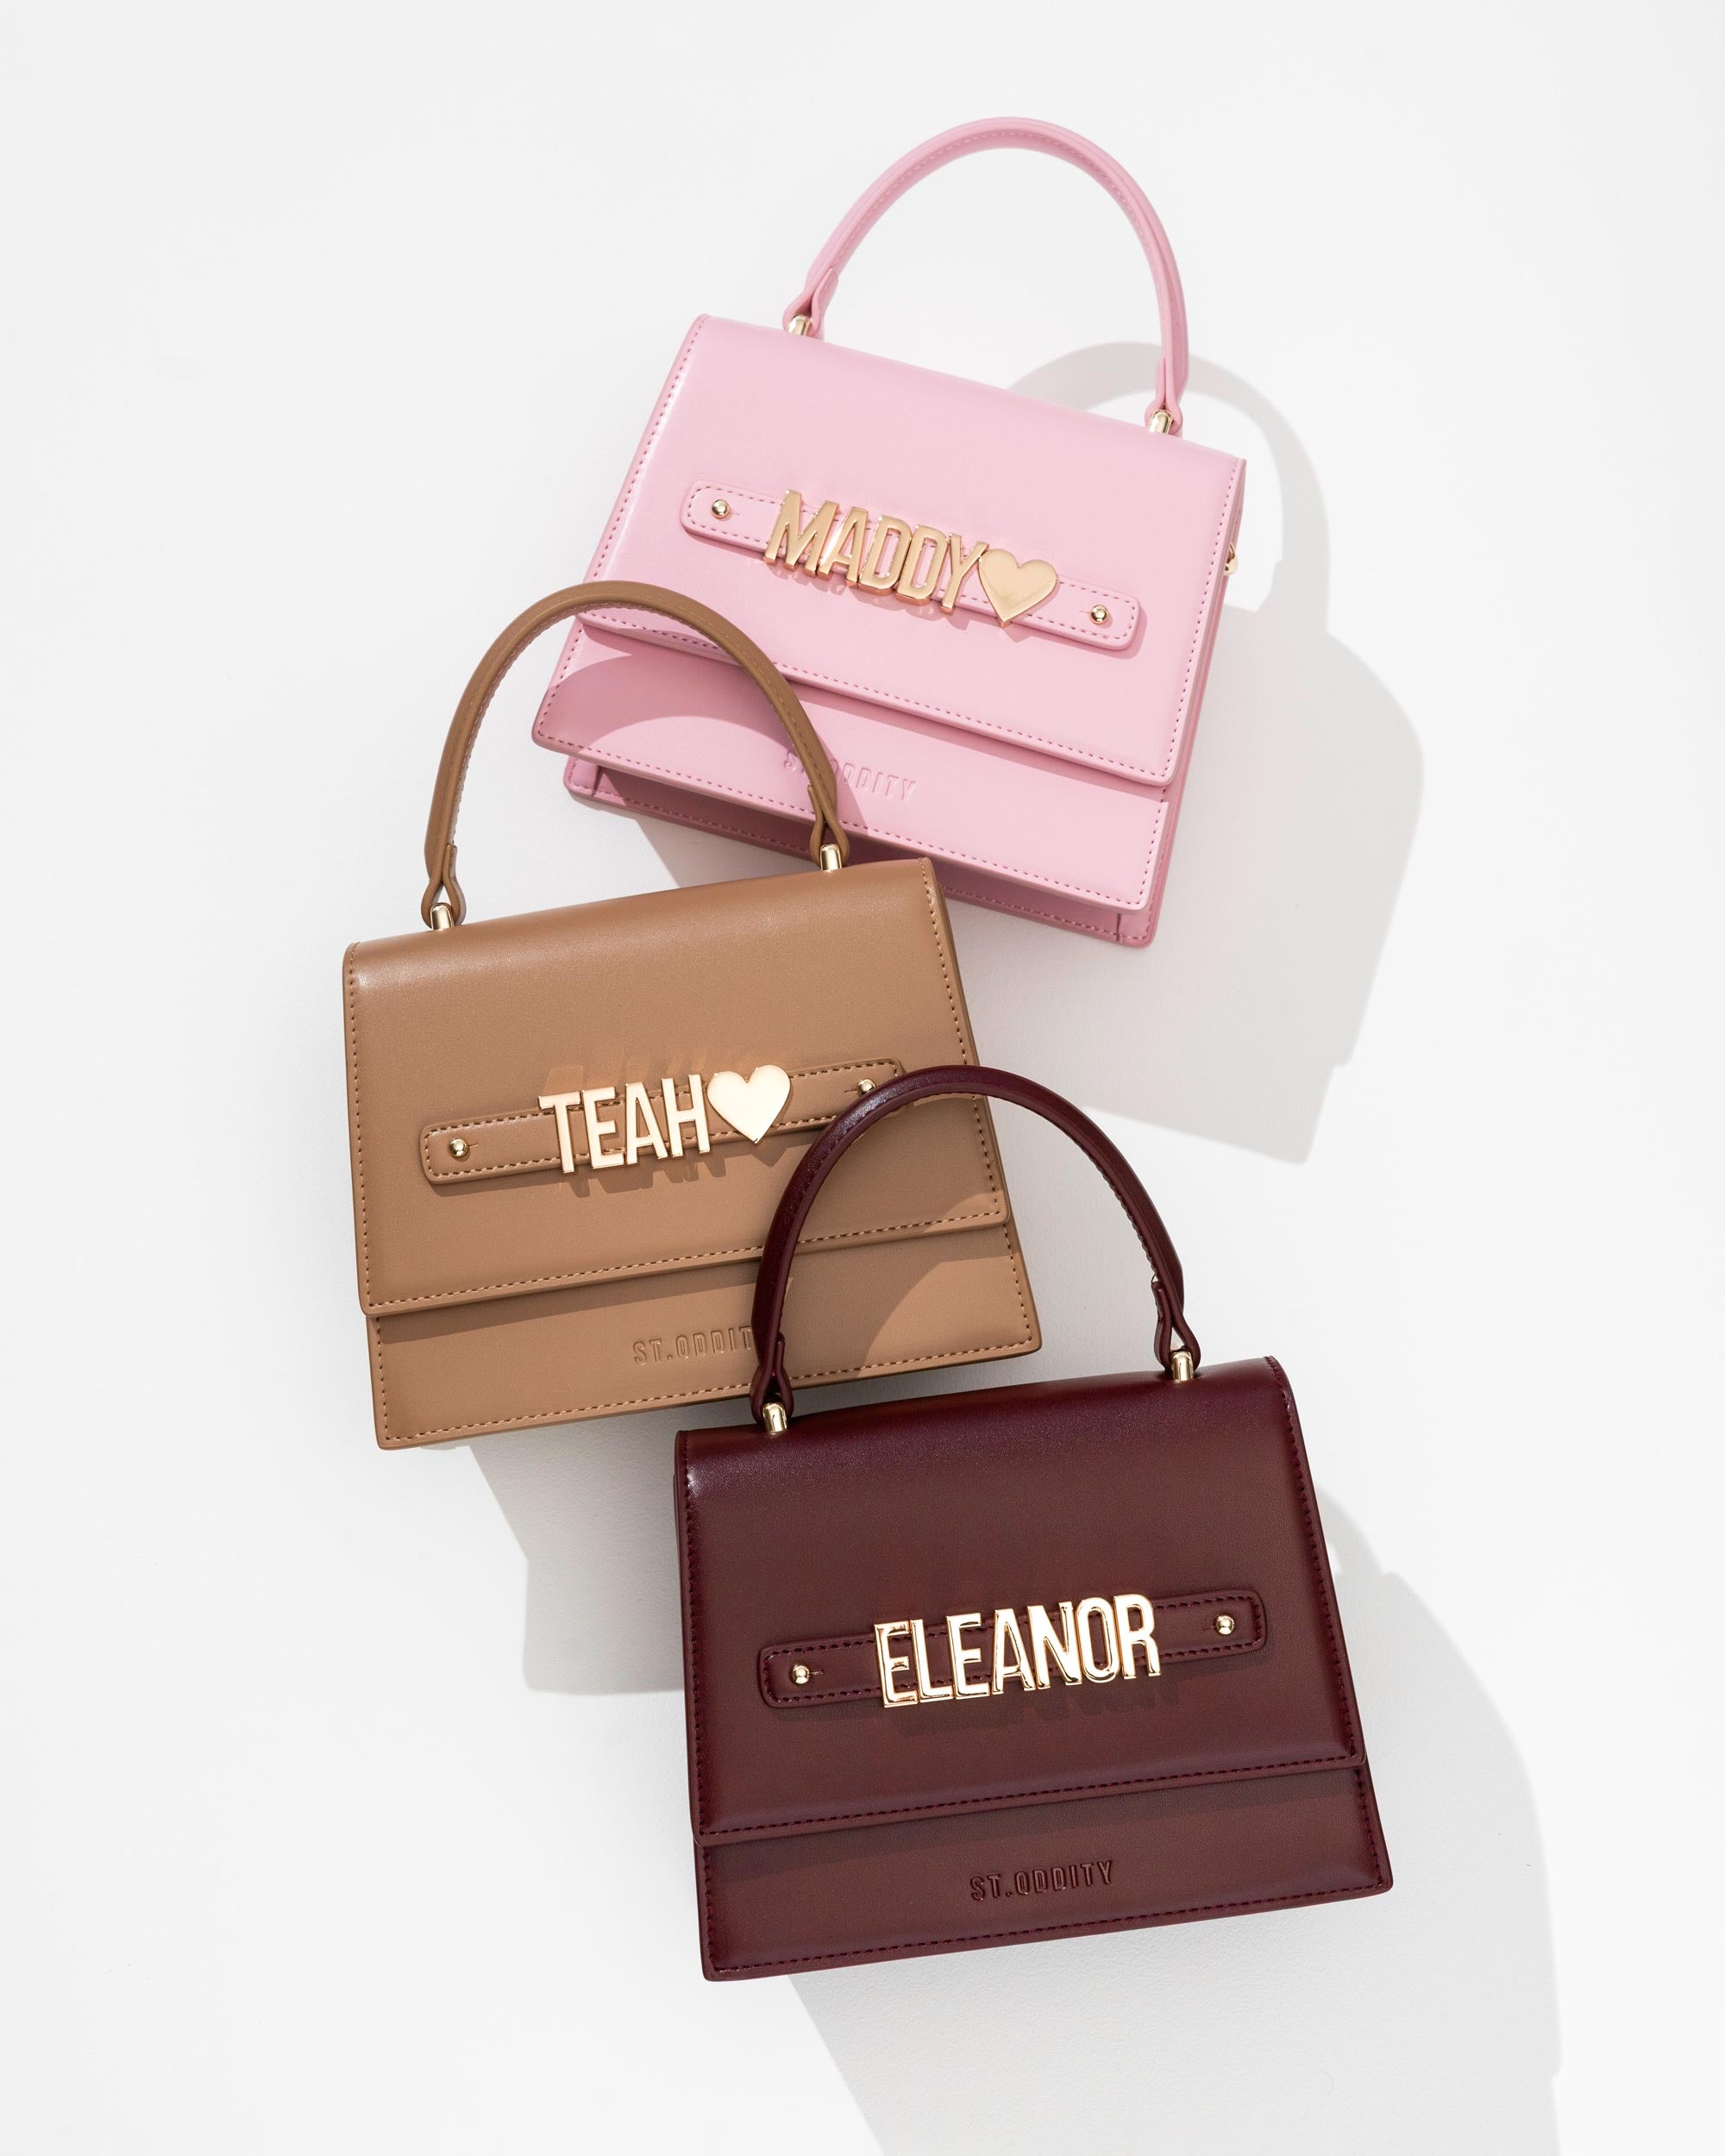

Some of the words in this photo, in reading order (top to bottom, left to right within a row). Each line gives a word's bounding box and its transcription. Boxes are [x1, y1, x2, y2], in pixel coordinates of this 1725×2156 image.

[763, 488, 989, 614] MADDY
[538, 1073, 711, 1174] TEAH
[632, 1325, 753, 1366] ST.ODDIT
[874, 1594, 1161, 1708] ELEANOR
[969, 1859, 1113, 1902] ST.ODDITY
